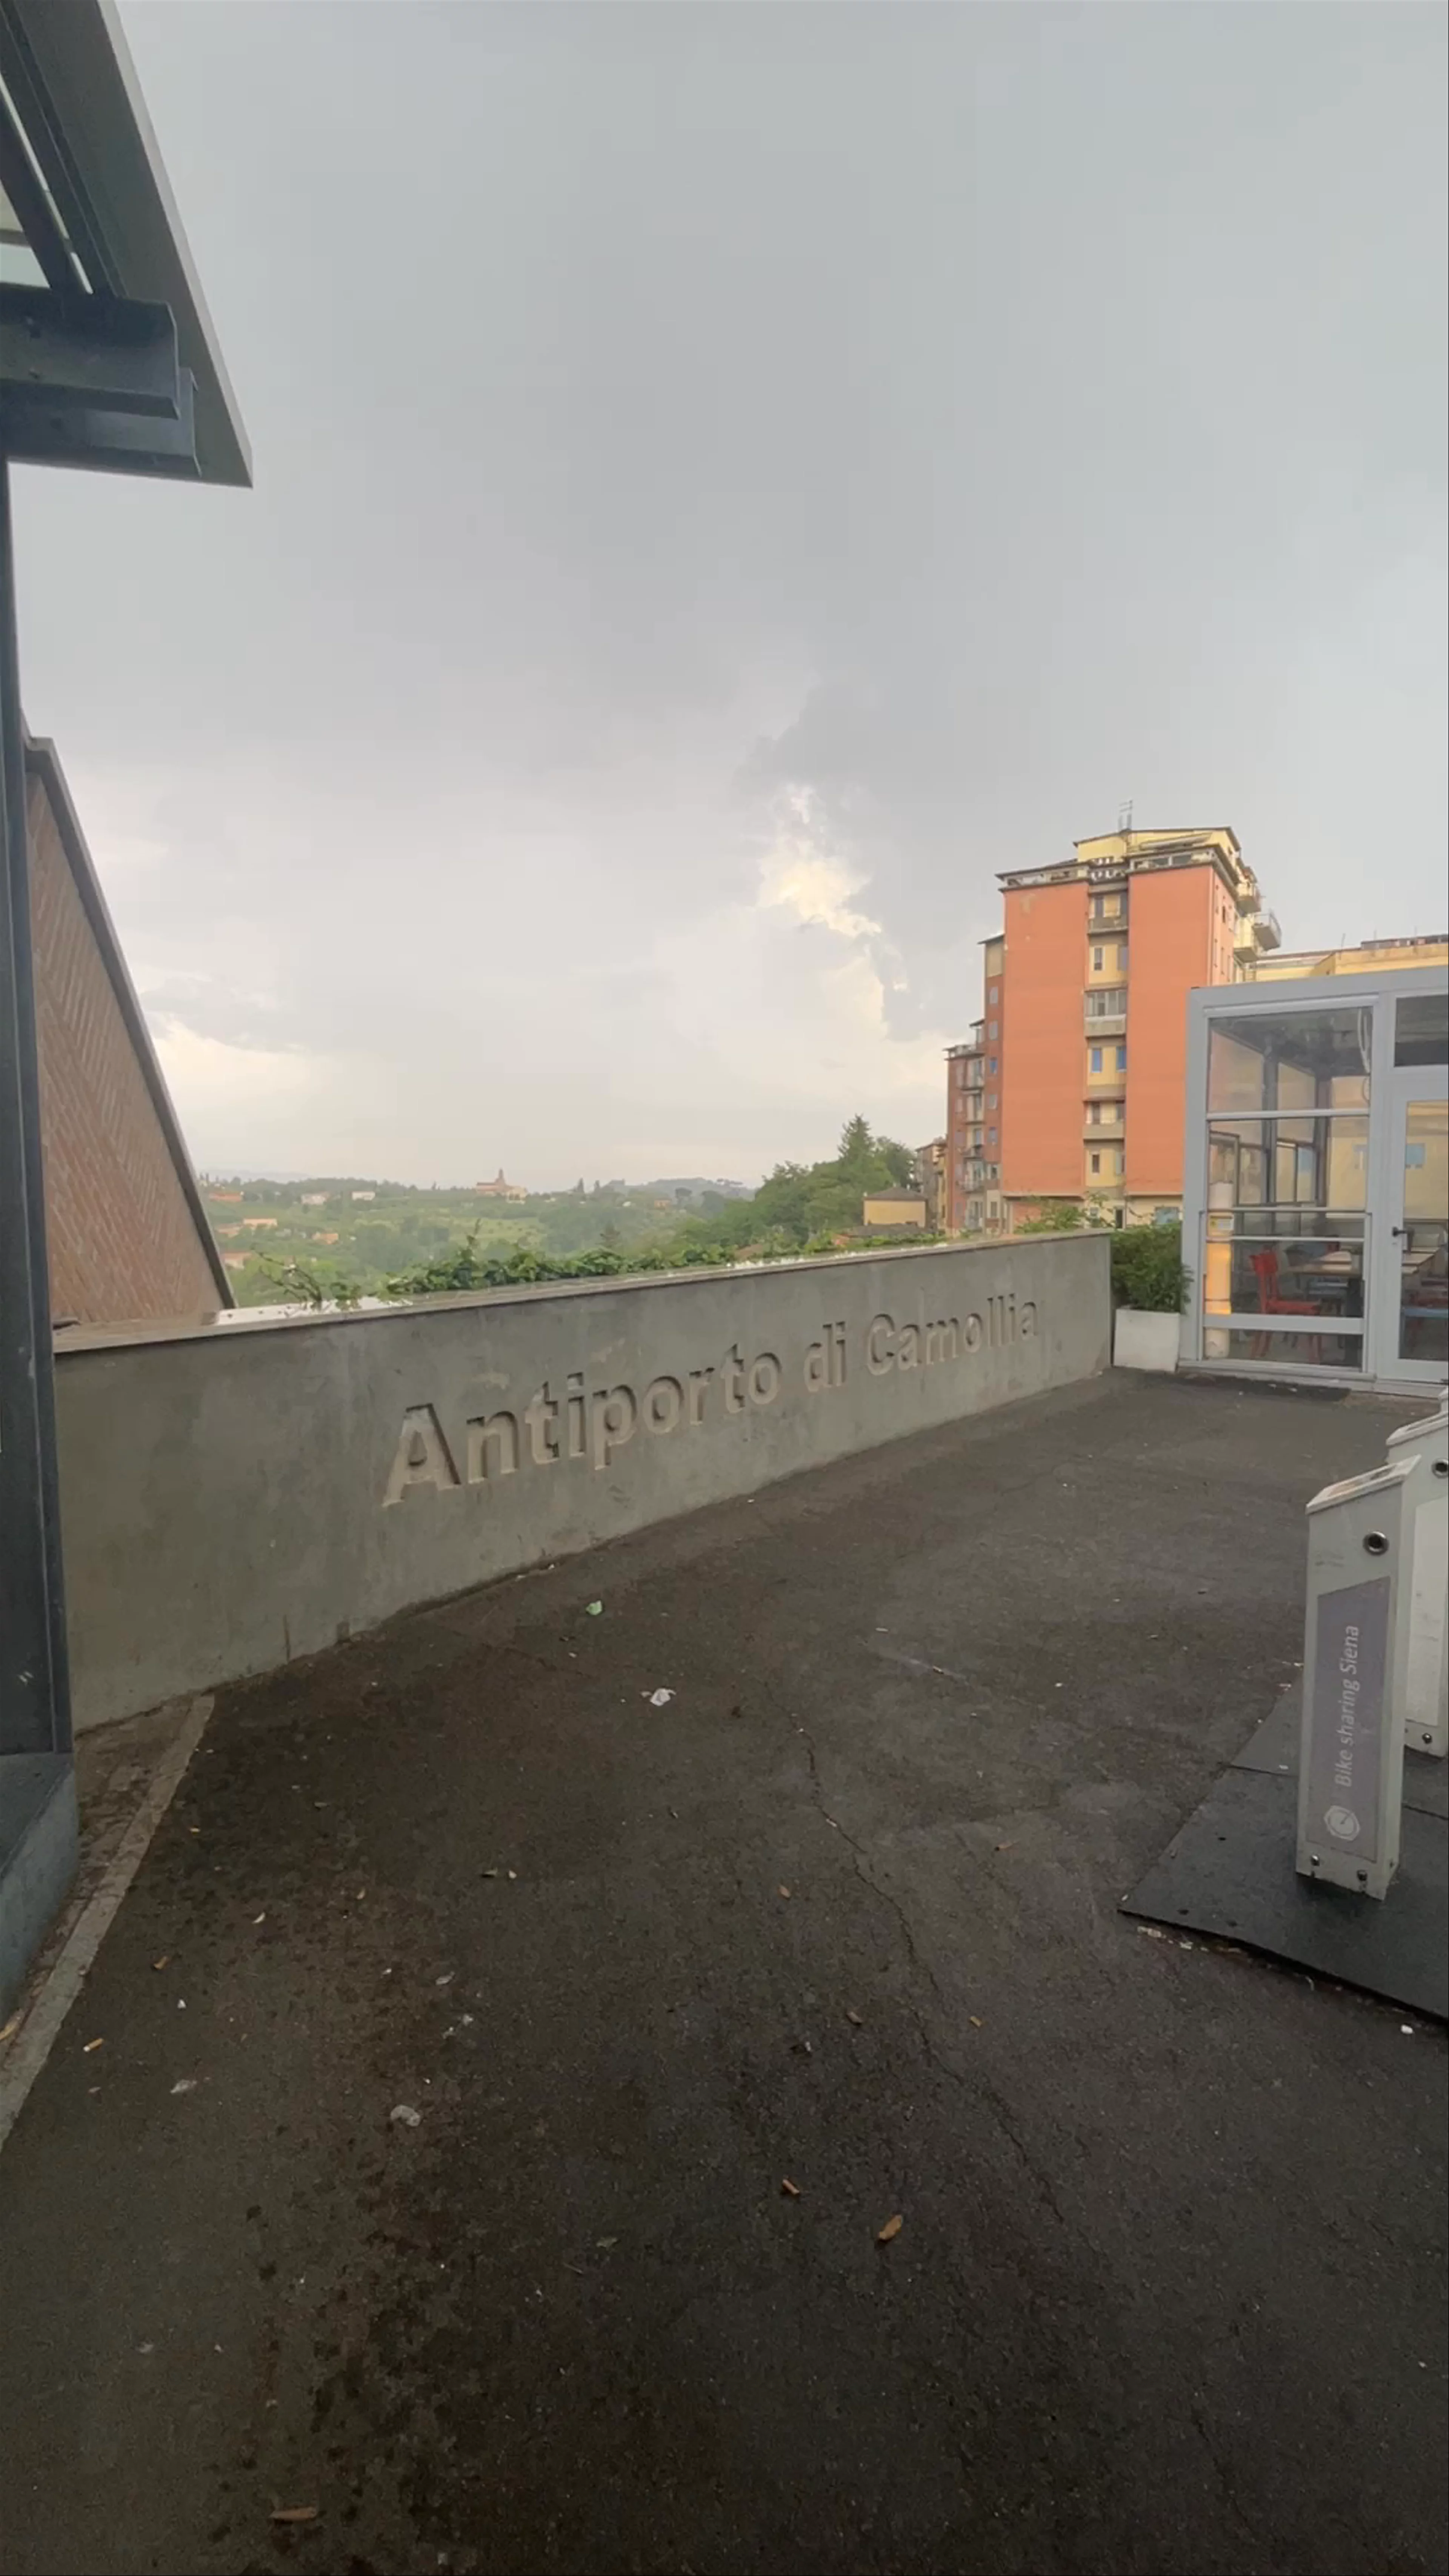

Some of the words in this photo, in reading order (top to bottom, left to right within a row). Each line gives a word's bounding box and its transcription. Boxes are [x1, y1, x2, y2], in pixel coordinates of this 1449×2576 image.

[382, 1343, 783, 1507] Antiporto
[804, 1321, 846, 1393] di
[868, 1293, 1038, 1375] Camollia
[1339, 1625, 1359, 1675] Siena
[1336, 1679, 1360, 1747] sharing
[1334, 1749, 1353, 1787] Bike
